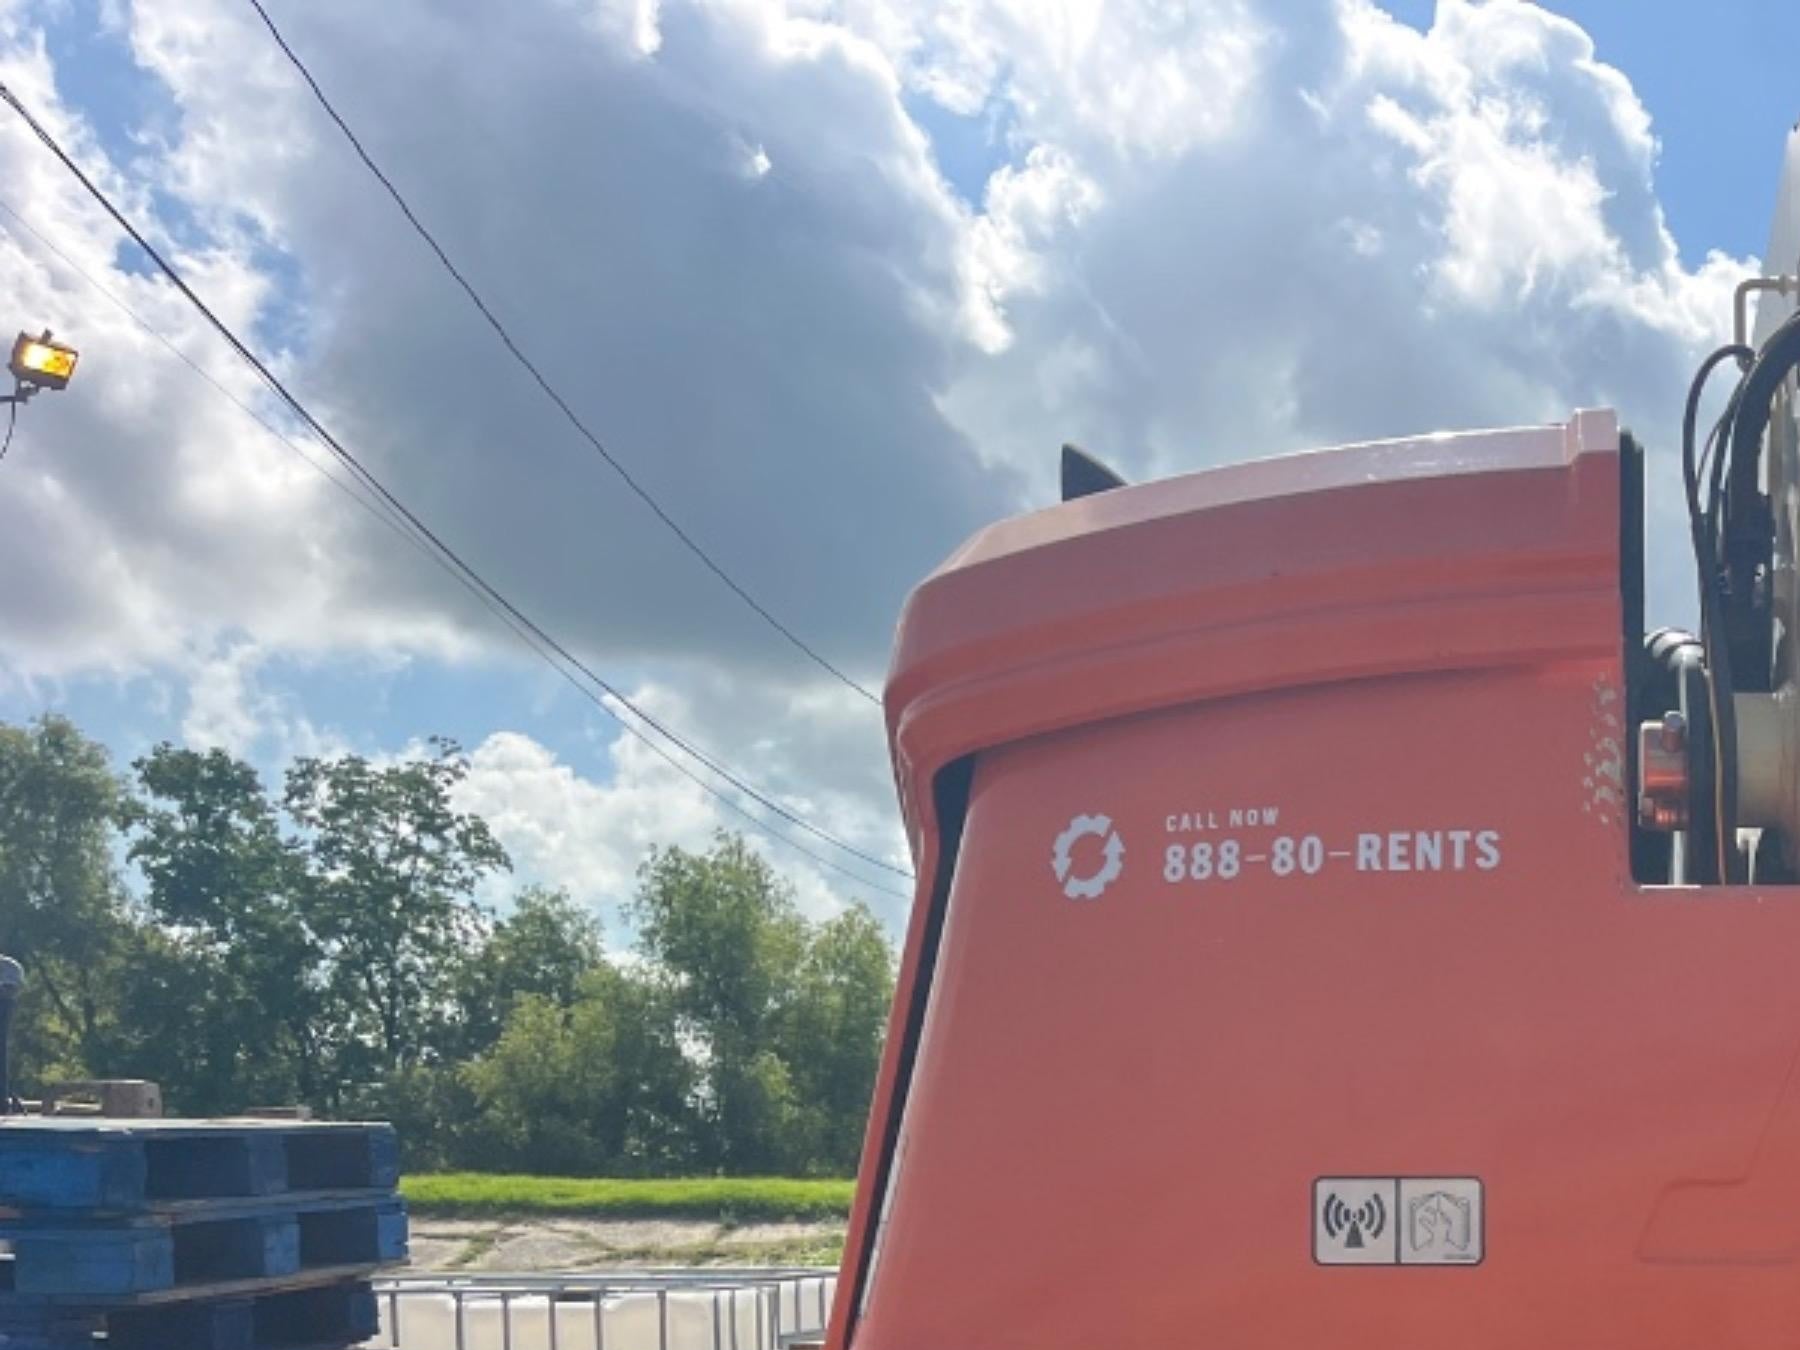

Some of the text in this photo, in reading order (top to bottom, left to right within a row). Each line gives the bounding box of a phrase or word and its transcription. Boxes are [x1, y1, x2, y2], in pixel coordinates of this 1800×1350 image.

[1166, 808, 1279, 832] CALL NOW
[1163, 830, 1501, 882] 888-80-RENTS
